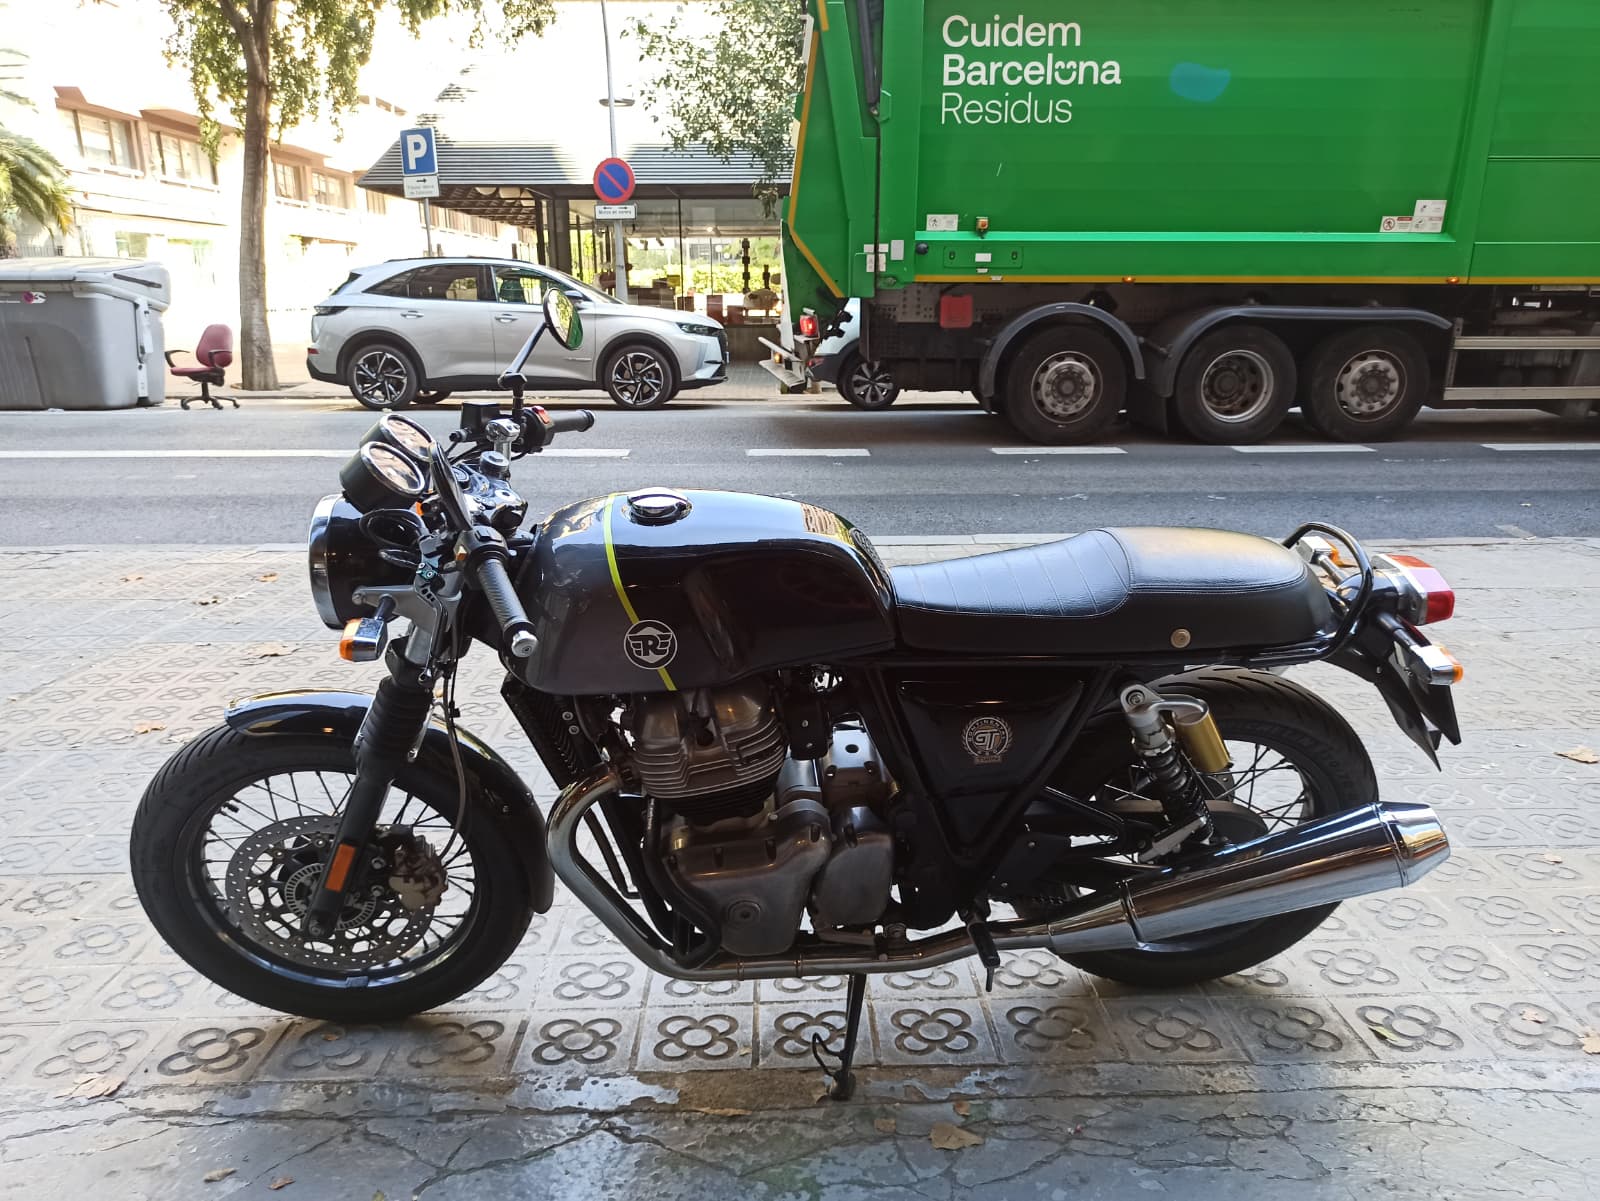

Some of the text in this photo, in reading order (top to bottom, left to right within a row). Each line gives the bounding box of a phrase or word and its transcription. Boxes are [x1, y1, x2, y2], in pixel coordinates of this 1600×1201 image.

[942, 14, 1081, 48] Cuidem
[943, 53, 1122, 86] Barcelona
[941, 91, 1073, 124] Residus
[406, 134, 427, 170] P
[975, 729, 1000, 750] GT
